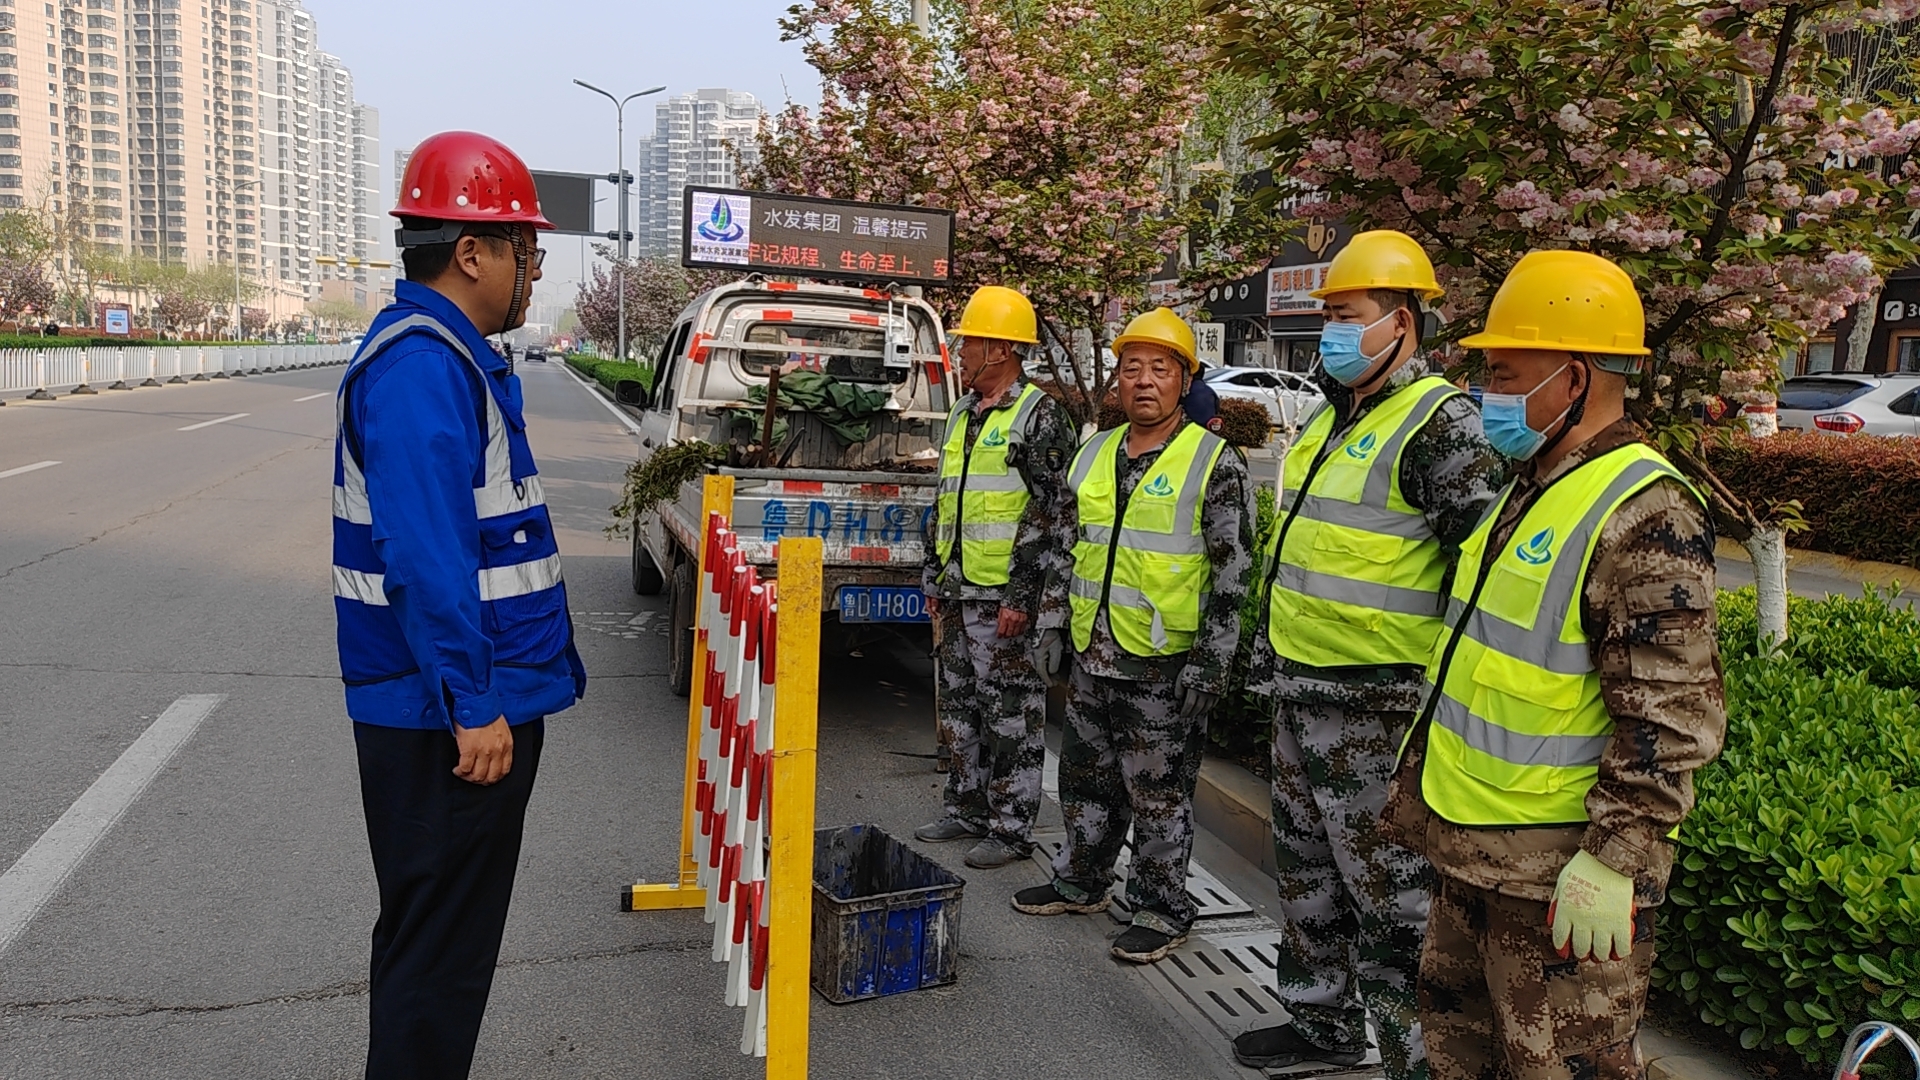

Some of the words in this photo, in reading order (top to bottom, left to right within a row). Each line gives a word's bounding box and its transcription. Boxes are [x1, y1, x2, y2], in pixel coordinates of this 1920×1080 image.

[763, 208, 841, 234] 水发集团
[852, 216, 928, 240] 温馨提示
